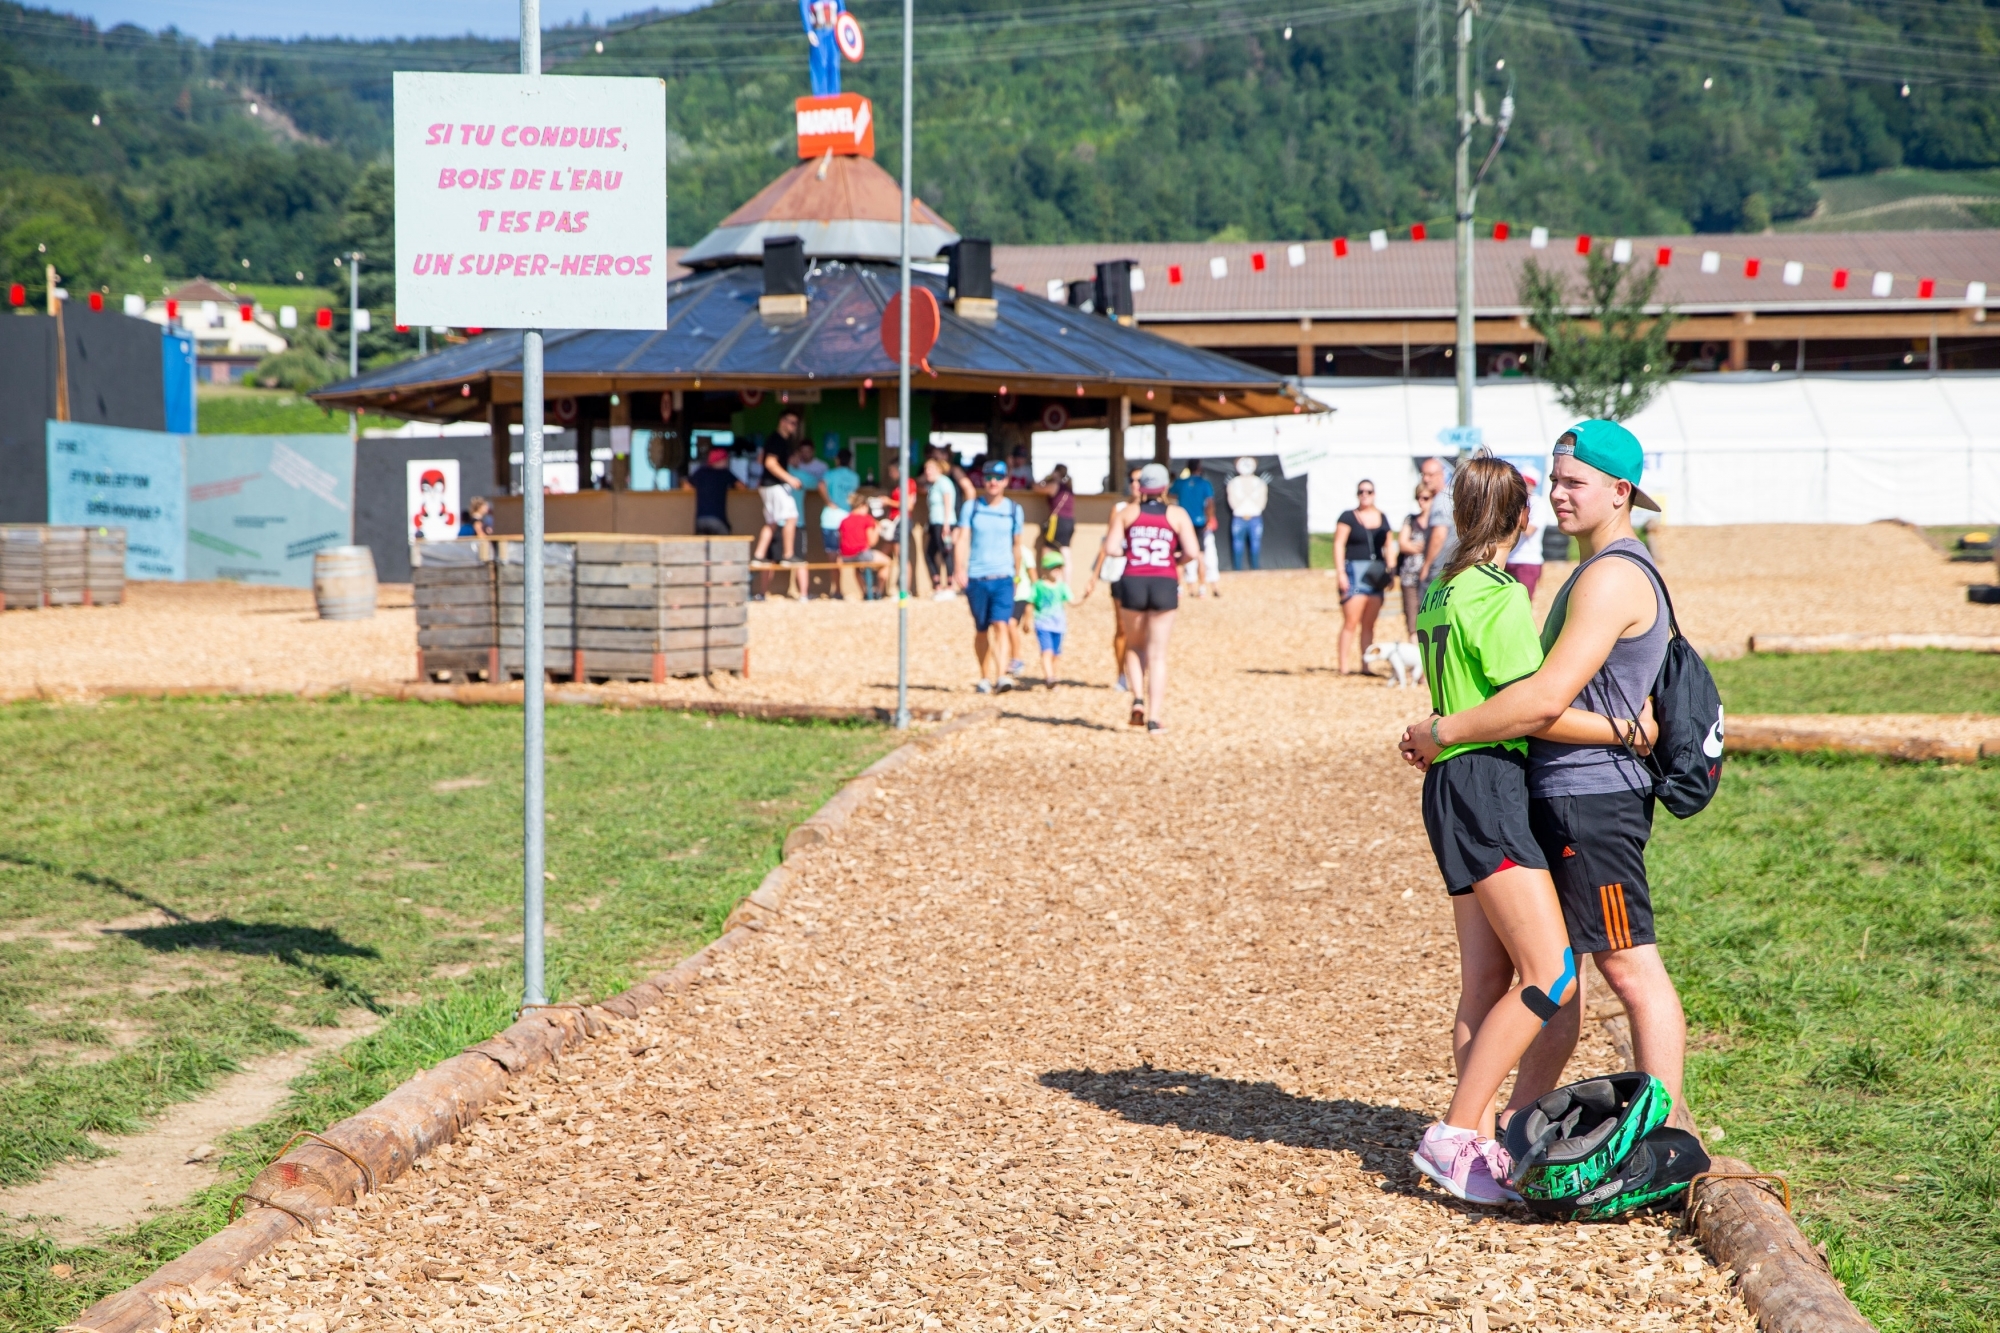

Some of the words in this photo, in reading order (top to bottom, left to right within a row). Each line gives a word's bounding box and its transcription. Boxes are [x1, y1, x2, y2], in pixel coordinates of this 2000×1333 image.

[797, 108, 855, 135] MARVEL
[425, 123, 454, 146] SI
[460, 124, 495, 147] TU
[501, 125, 628, 152] CONDUIS,
[438, 168, 506, 190] BOIS
[509, 168, 546, 191] DE
[550, 167, 623, 191] L'EAU
[498, 210, 532, 233] ES
[535, 211, 590, 233] PAS
[412, 253, 454, 276] UN
[458, 254, 653, 277] SUPER-HEROS
[1130, 538, 1170, 566] 52
[1582, 1184, 1618, 1203] NEXO
